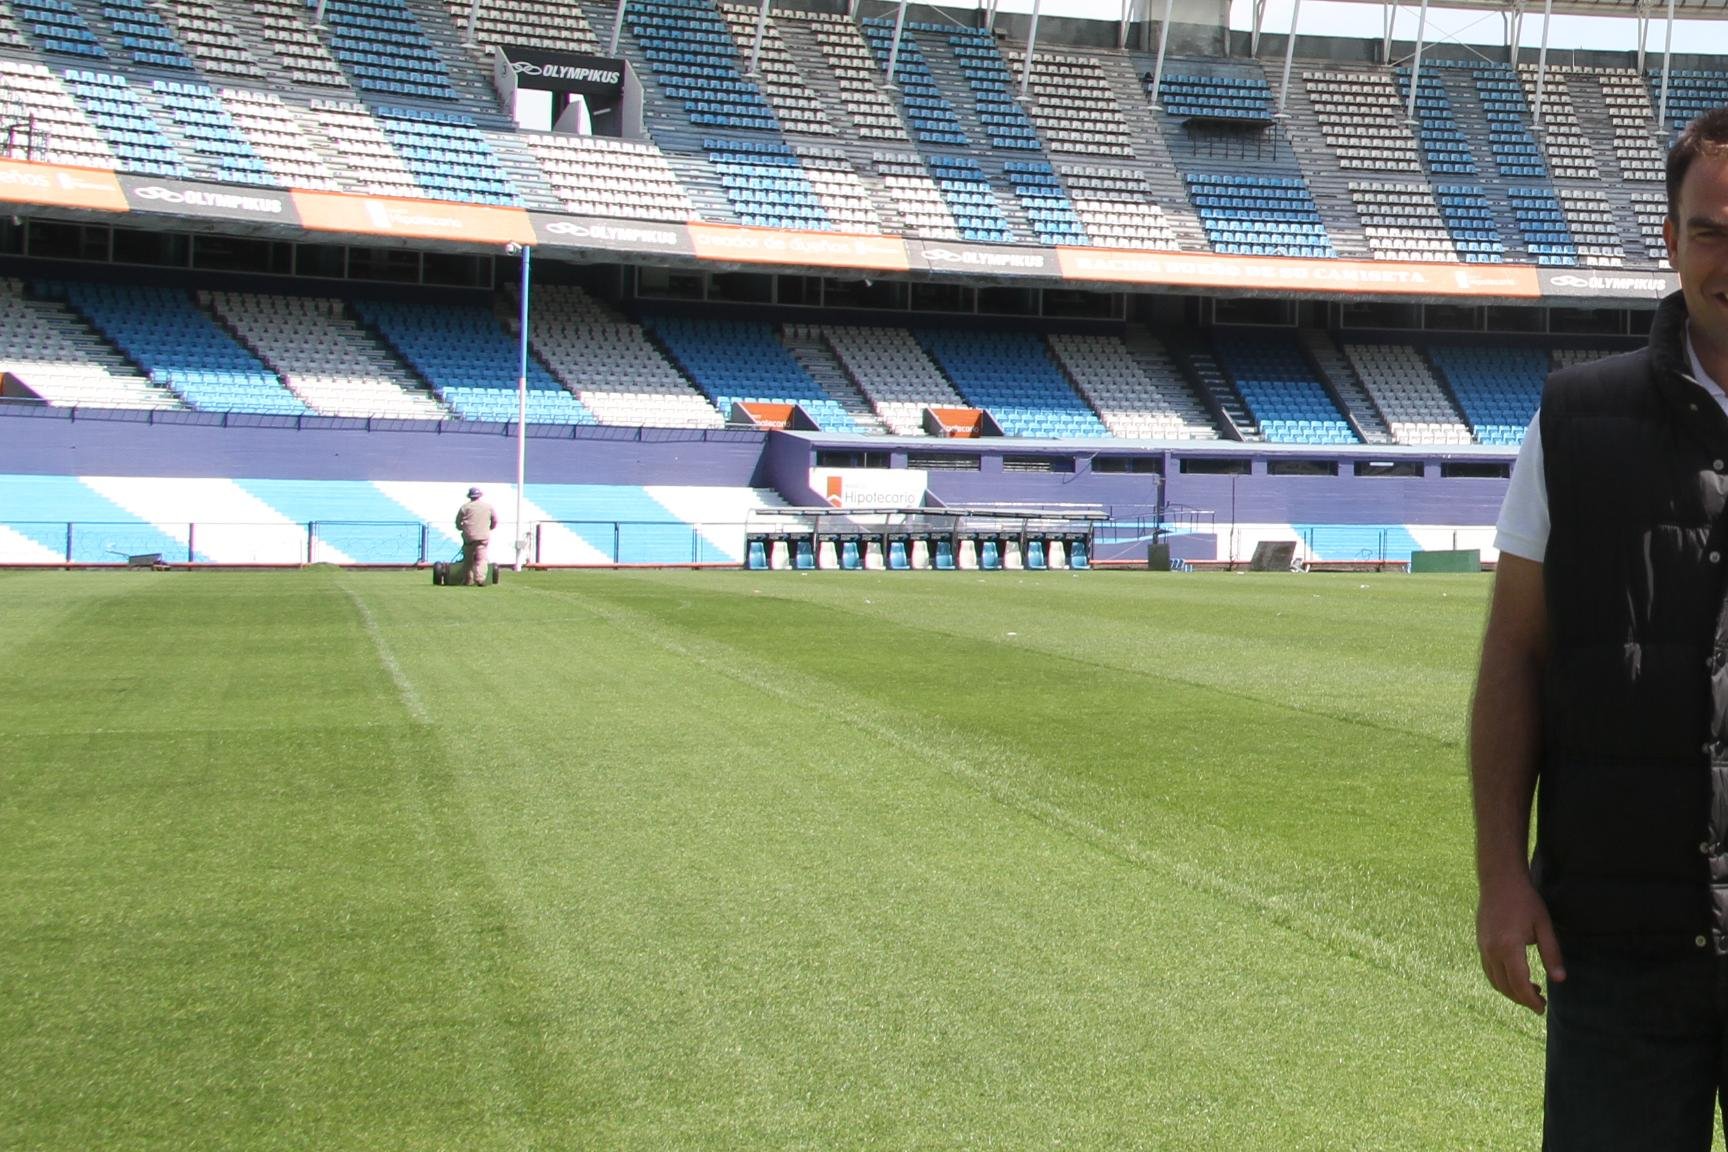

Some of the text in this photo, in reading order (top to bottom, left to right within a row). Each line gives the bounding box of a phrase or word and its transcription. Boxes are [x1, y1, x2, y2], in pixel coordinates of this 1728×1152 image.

[542, 64, 620, 84] OLYMPIKUS
[184, 190, 282, 213] OLYMPIKUS
[590, 225, 677, 245] OLYMPIKUS
[960, 251, 1044, 268] OLYMPIKUS
[1588, 277, 1666, 291] OLYMPIKUS
[845, 491, 916, 505] Hipotecario
